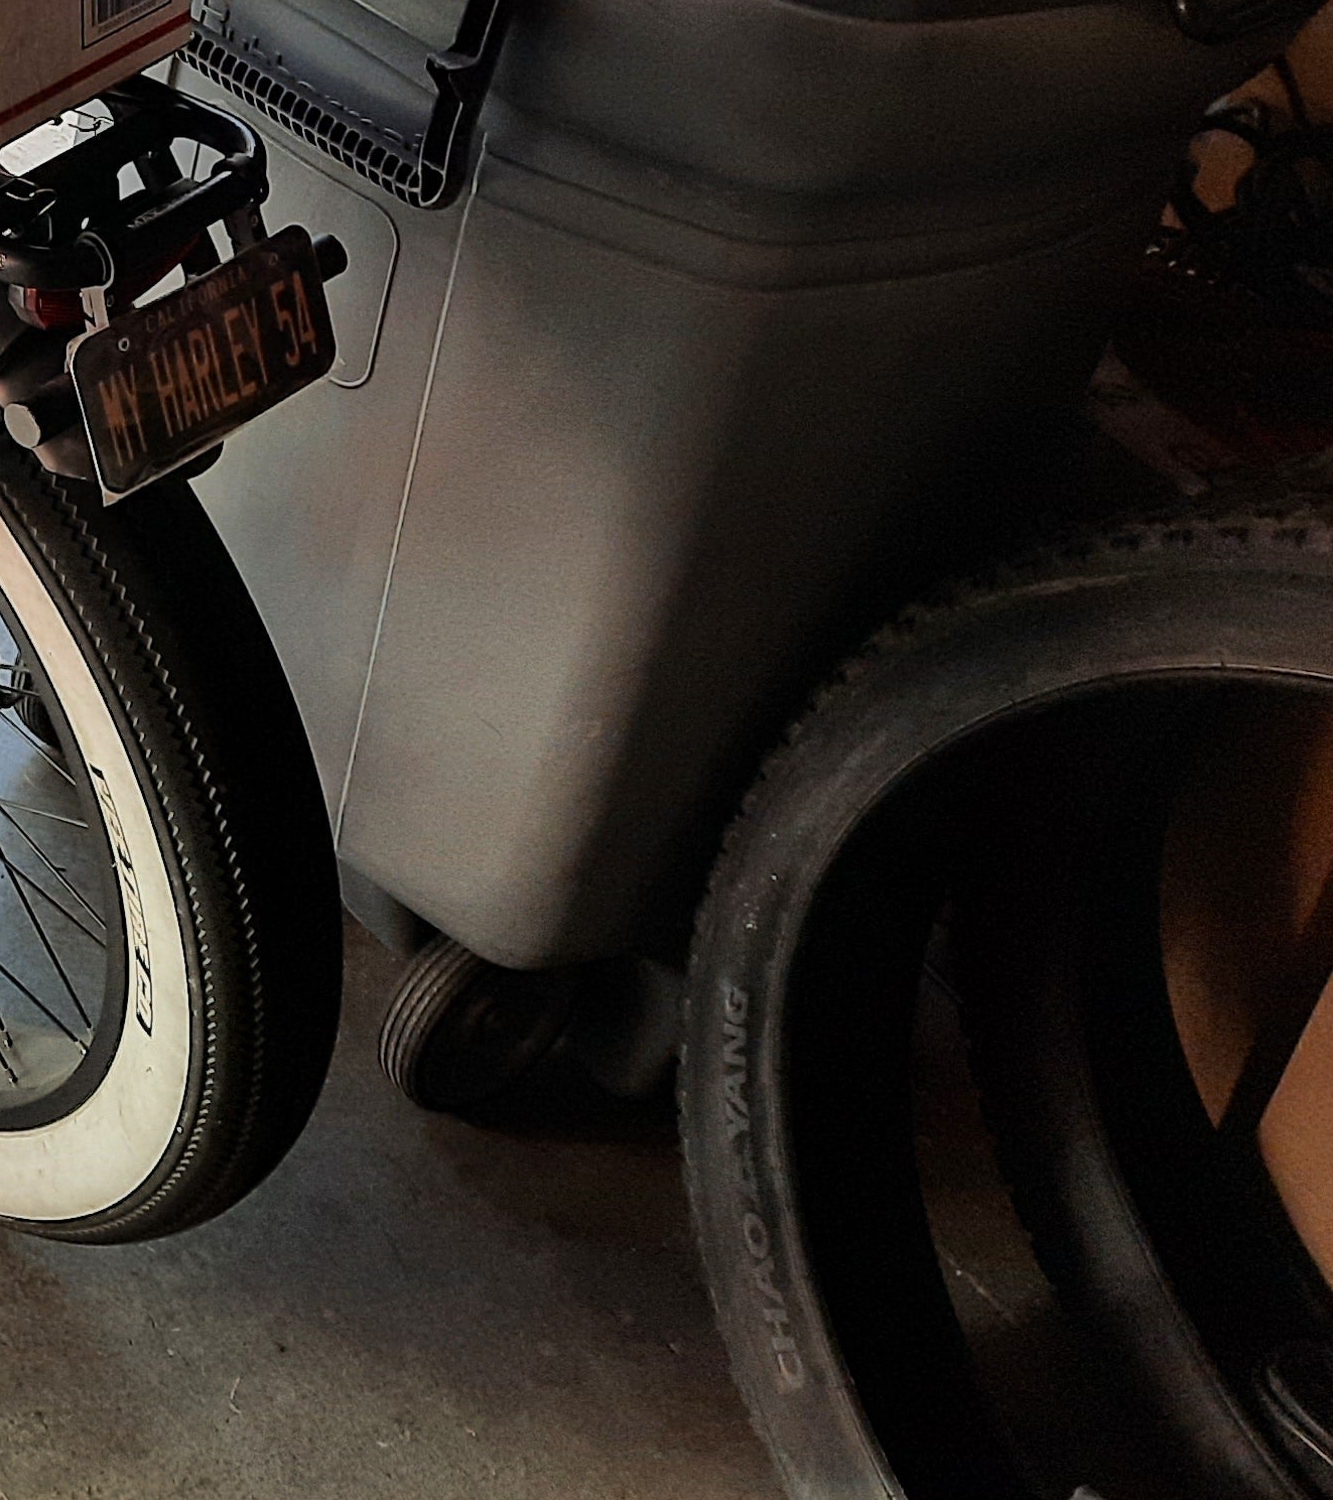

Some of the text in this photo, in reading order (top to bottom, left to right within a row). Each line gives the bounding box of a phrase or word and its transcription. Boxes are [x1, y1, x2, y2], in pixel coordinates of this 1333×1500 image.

[98, 269, 318, 468] MY HARLEY 54
[722, 980, 805, 1392] CHAO YANG
